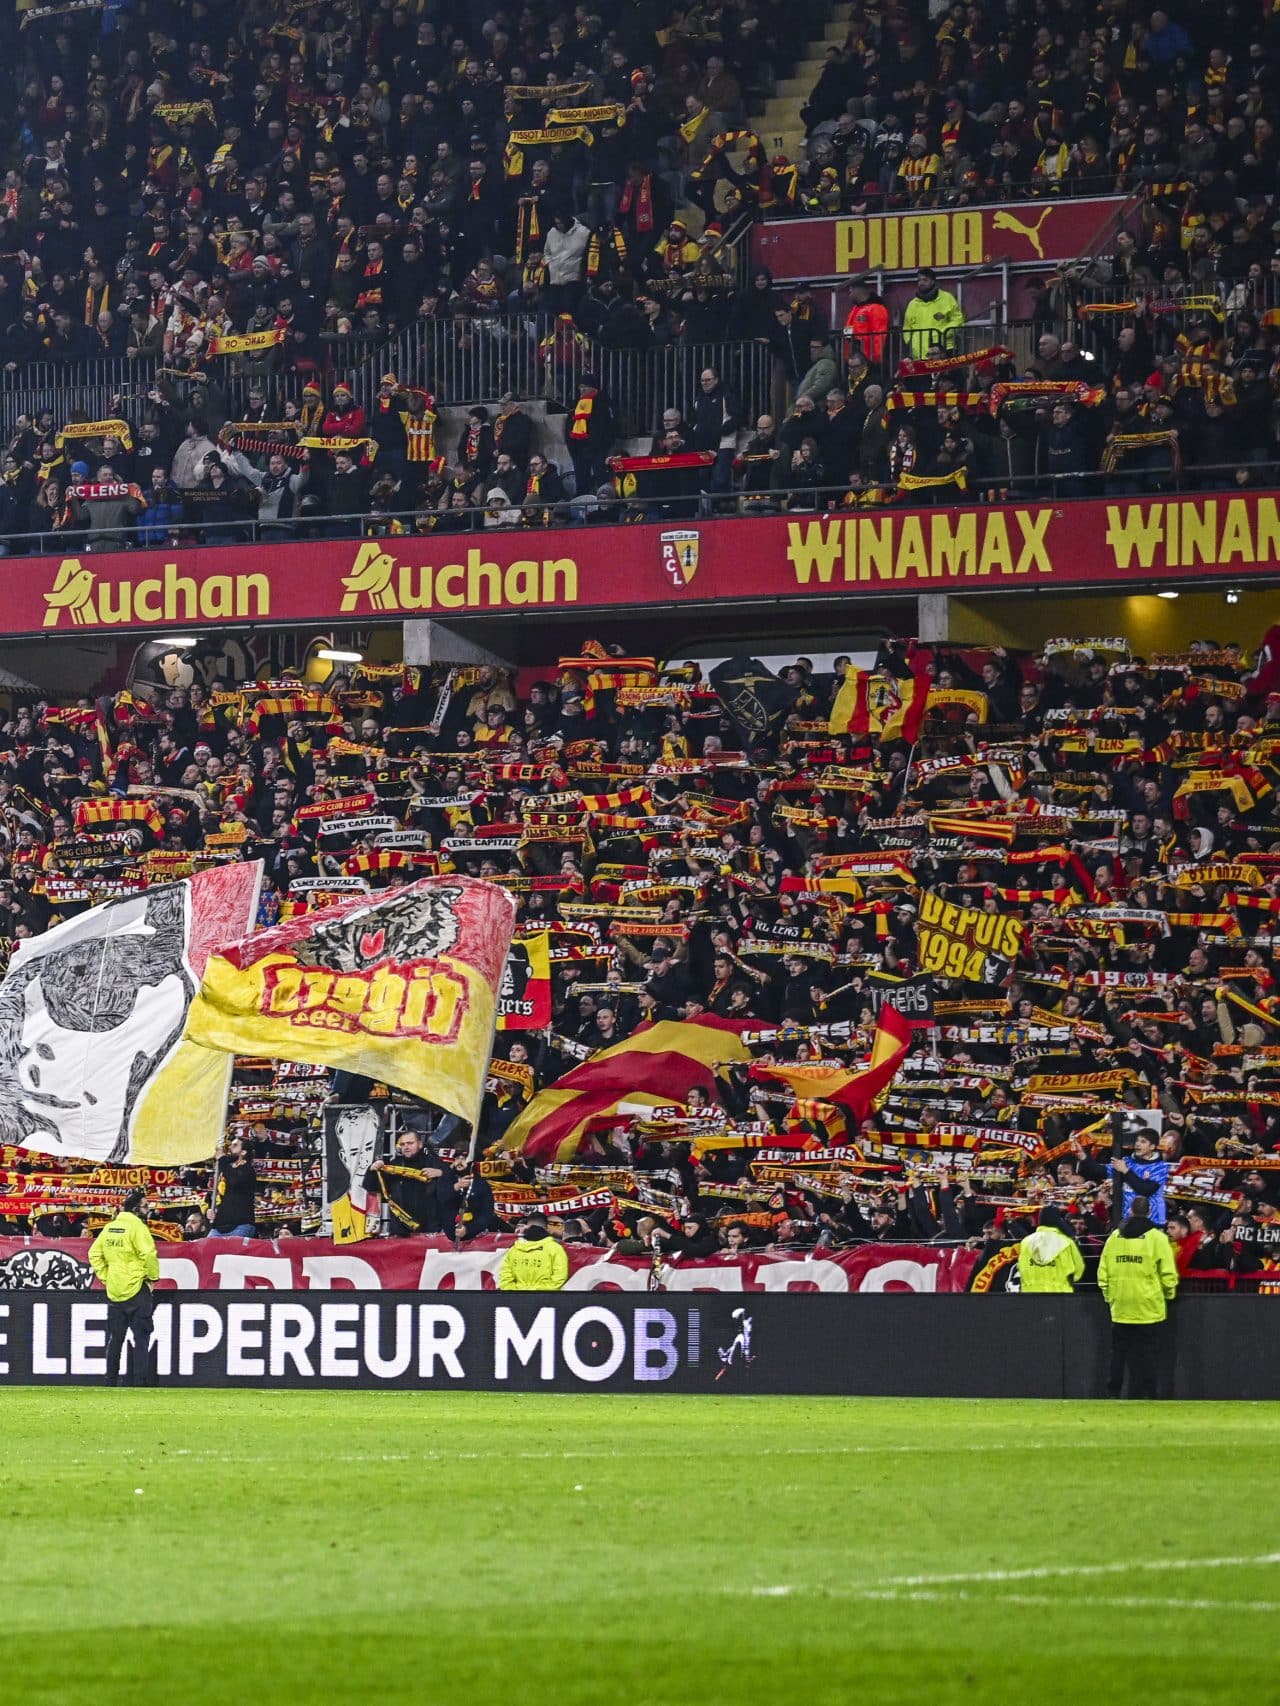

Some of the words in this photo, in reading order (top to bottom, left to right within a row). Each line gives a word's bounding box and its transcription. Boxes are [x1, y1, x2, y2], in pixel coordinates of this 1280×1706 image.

[513, 130, 539, 139] TISSOT
[773, 137, 783, 148] 11
[835, 211, 983, 273] PUMA
[90, 482, 128, 498] LENS
[786, 508, 1052, 583] WINAMAX
[340, 543, 577, 611] Auchan
[43, 559, 270, 626] Auchan
[671, 682, 695, 692] Allez
[1098, 740, 1125, 750] LENS
[923, 756, 962, 773] ENS
[299, 803, 325, 815] RACING
[326, 801, 343, 811] CLUB
[351, 798, 367, 808] LENS
[420, 797, 436, 805] LENS
[437, 793, 473, 804] CAPITALE
[1039, 803, 1080, 819] LENS
[322, 820, 352, 831] LENS
[355, 816, 393, 828] CAPITALE
[447, 838, 473, 848] LENS
[474, 837, 520, 848] CAPITALE
[45, 880, 75, 889] LENS
[291, 878, 318, 889] LENS
[319, 877, 361, 887] CAPITALE
[57, 889, 88, 899] LENS
[107, 886, 139, 897] FANS
[570, 907, 599, 915] LENS
[772, 919, 800, 935] LENS
[922, 892, 1023, 957] DEPUIS
[920, 931, 986, 982] 1994
[870, 984, 929, 1013] TIGERS
[496, 998, 534, 1016] gers
[1040, 1074, 1071, 1087] RED
[1077, 1069, 1128, 1085] TIGERS
[974, 1127, 1038, 1151] TIGERS
[157, 1186, 193, 1197] LENS
[536, 1190, 612, 1213] TIGERS
[1236, 1226, 1254, 1241] RC
[1256, 1228, 1280, 1243] LEN
